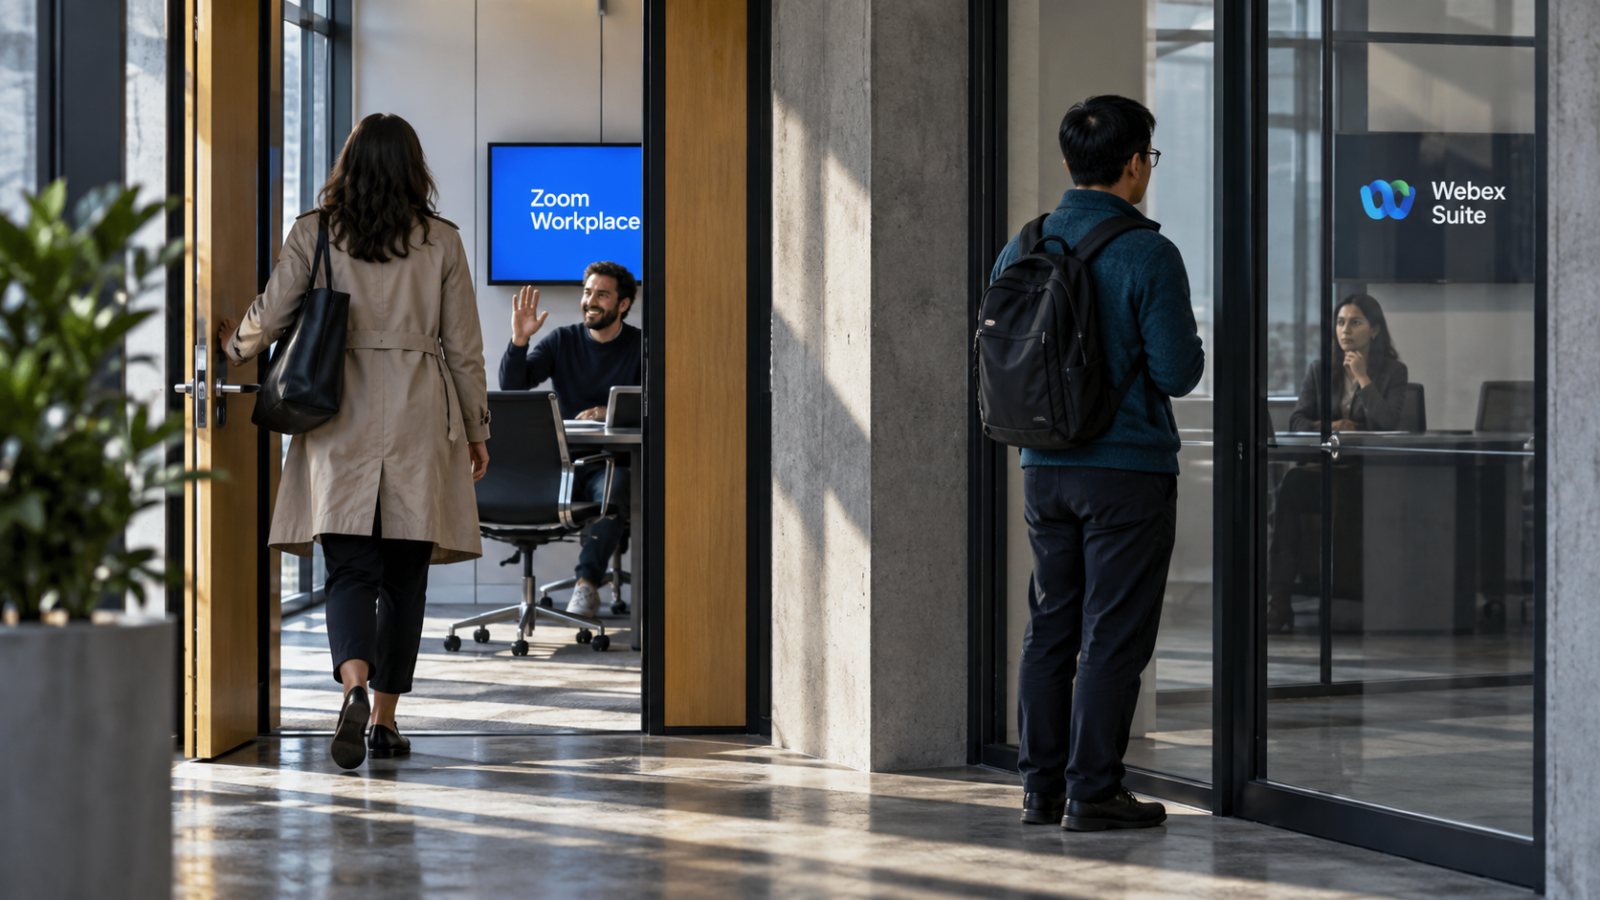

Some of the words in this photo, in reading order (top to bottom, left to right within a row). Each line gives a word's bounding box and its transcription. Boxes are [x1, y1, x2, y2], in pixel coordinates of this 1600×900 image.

[530, 188, 590, 207] Zoom
[1431, 181, 1506, 200] Webex
[530, 211, 641, 235] Workplace
[1431, 205, 1487, 224] Suite
